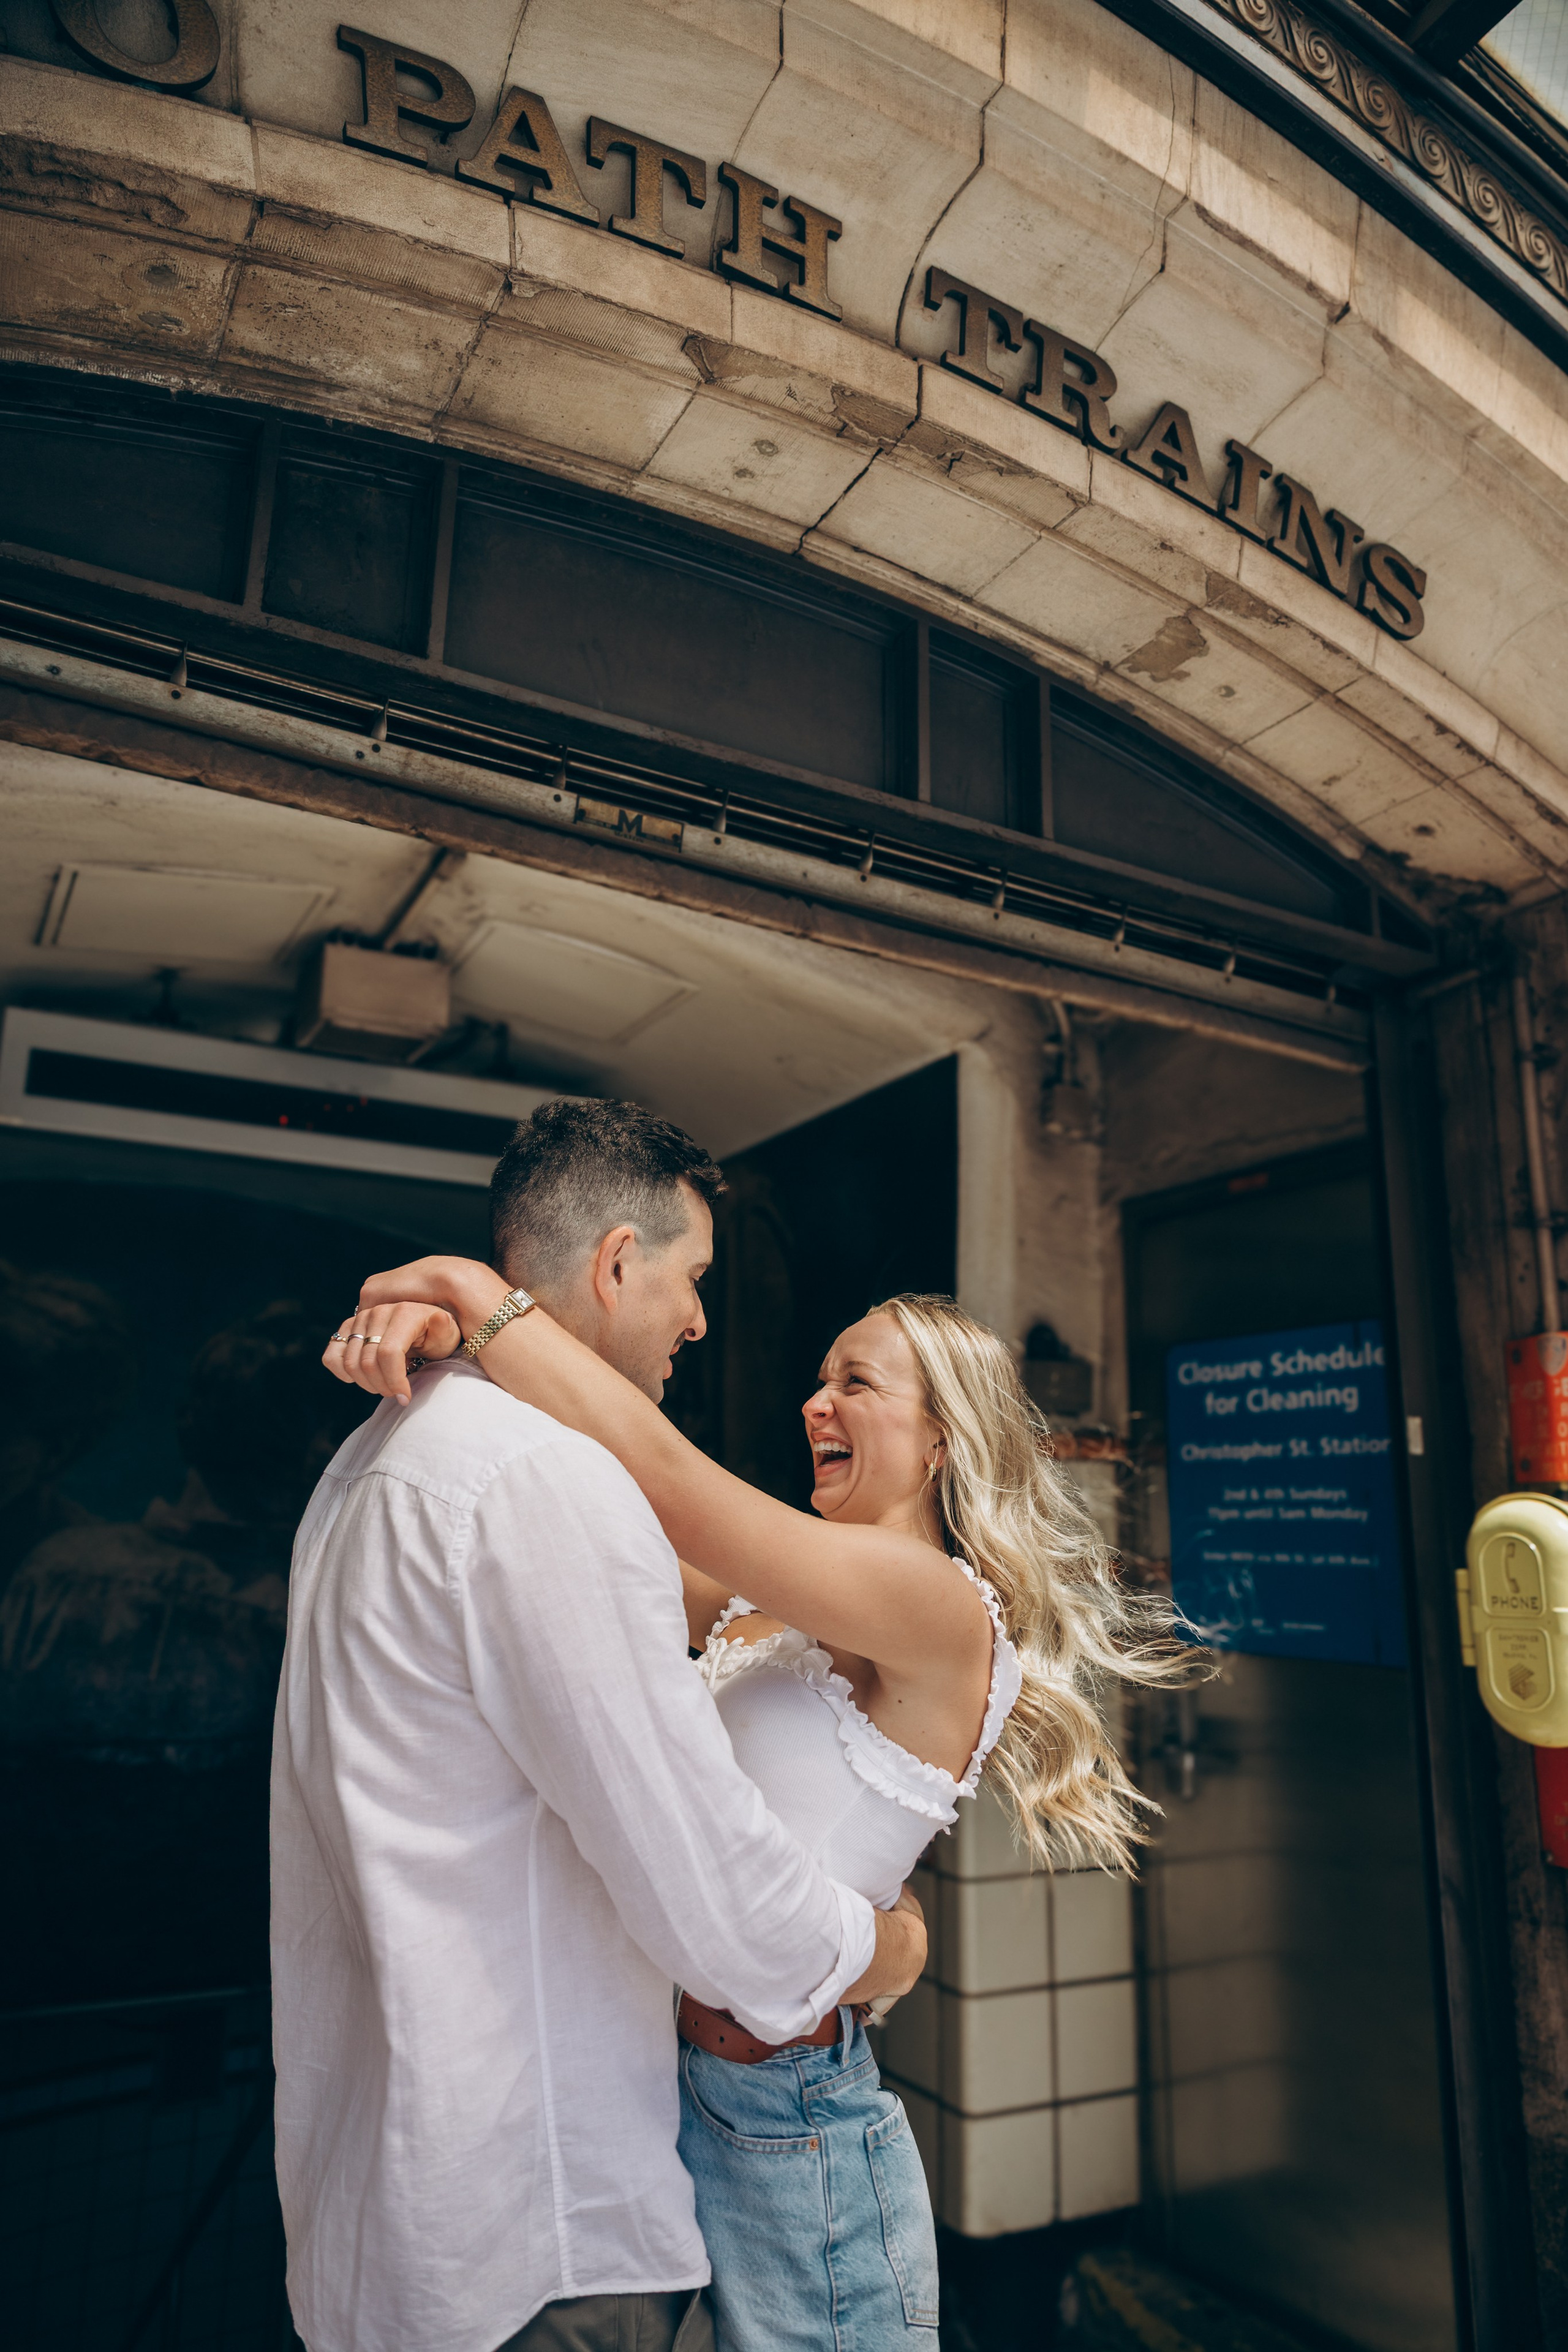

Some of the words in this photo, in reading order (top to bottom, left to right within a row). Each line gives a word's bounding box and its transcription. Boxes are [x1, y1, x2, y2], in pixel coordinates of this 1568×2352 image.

[337, 24, 843, 323] PATH
[924, 265, 1428, 641] TRAINS
[1178, 1360, 1263, 1385] Closure
[1205, 1392, 1238, 1414] for
[1246, 1382, 1359, 1412] Cleaning
[1491, 1595, 1539, 1610] PHONE
